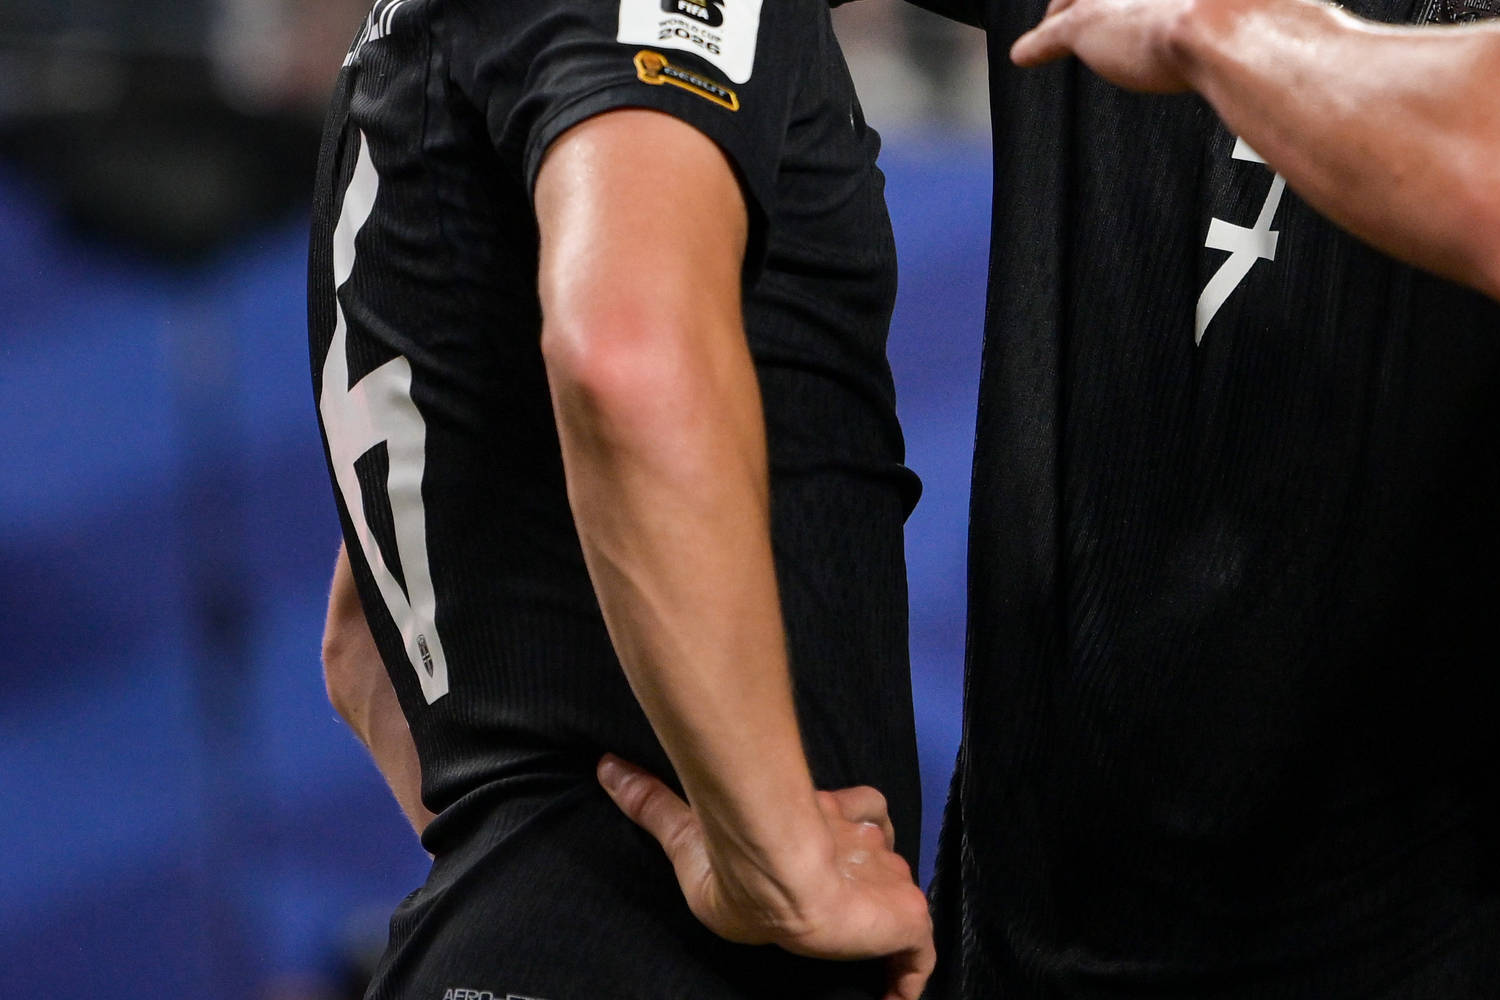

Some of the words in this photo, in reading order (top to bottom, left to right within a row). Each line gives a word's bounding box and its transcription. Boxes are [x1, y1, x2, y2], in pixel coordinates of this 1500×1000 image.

[658, 27, 721, 55] 2026
[677, 0, 710, 21] FIFA
[1195, 135, 1287, 347] 7
[320, 128, 449, 706] 6
